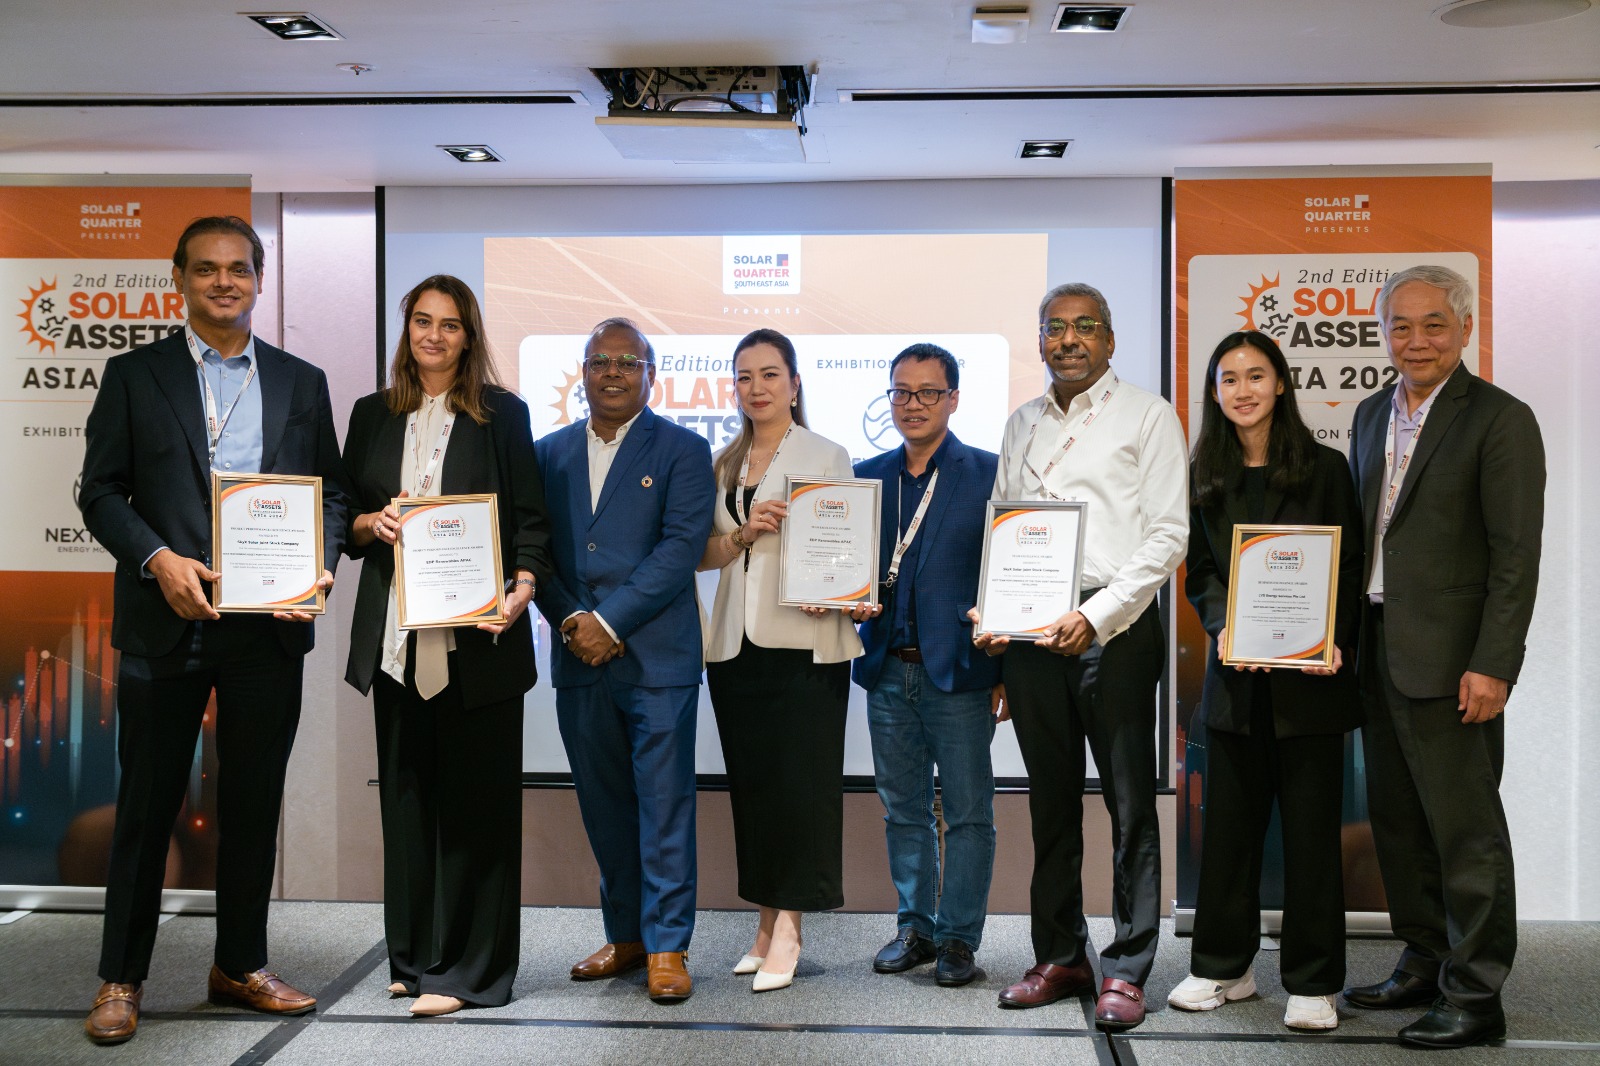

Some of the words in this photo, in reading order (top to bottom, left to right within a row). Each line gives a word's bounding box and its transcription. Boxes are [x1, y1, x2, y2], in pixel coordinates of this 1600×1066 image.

[1304, 197, 1351, 207] SOLAR
[81, 204, 123, 214] SOLAR
[1304, 211, 1371, 222] QUARTER
[80, 218, 142, 229] QUARTER
[80, 232, 141, 240] PRESENTS
[733, 255, 773, 264] SOLAR
[733, 268, 790, 278] QUARTER
[1297, 268, 1334, 284] 2nd
[1341, 268, 1395, 284] Editi
[72, 273, 107, 288] 2nd
[68, 291, 185, 320] SOLAR
[1292, 287, 1381, 317] SOL
[723, 307, 800, 315] Presents
[1289, 321, 1382, 348] ASSE
[817, 359, 892, 369] EXHIBITIO
[22, 366, 99, 390] ASIA
[1290, 366, 1327, 390] IA
[1339, 365, 1400, 390] 202
[648, 377, 738, 410] LAR
[23, 426, 87, 437] EXHIBITI
